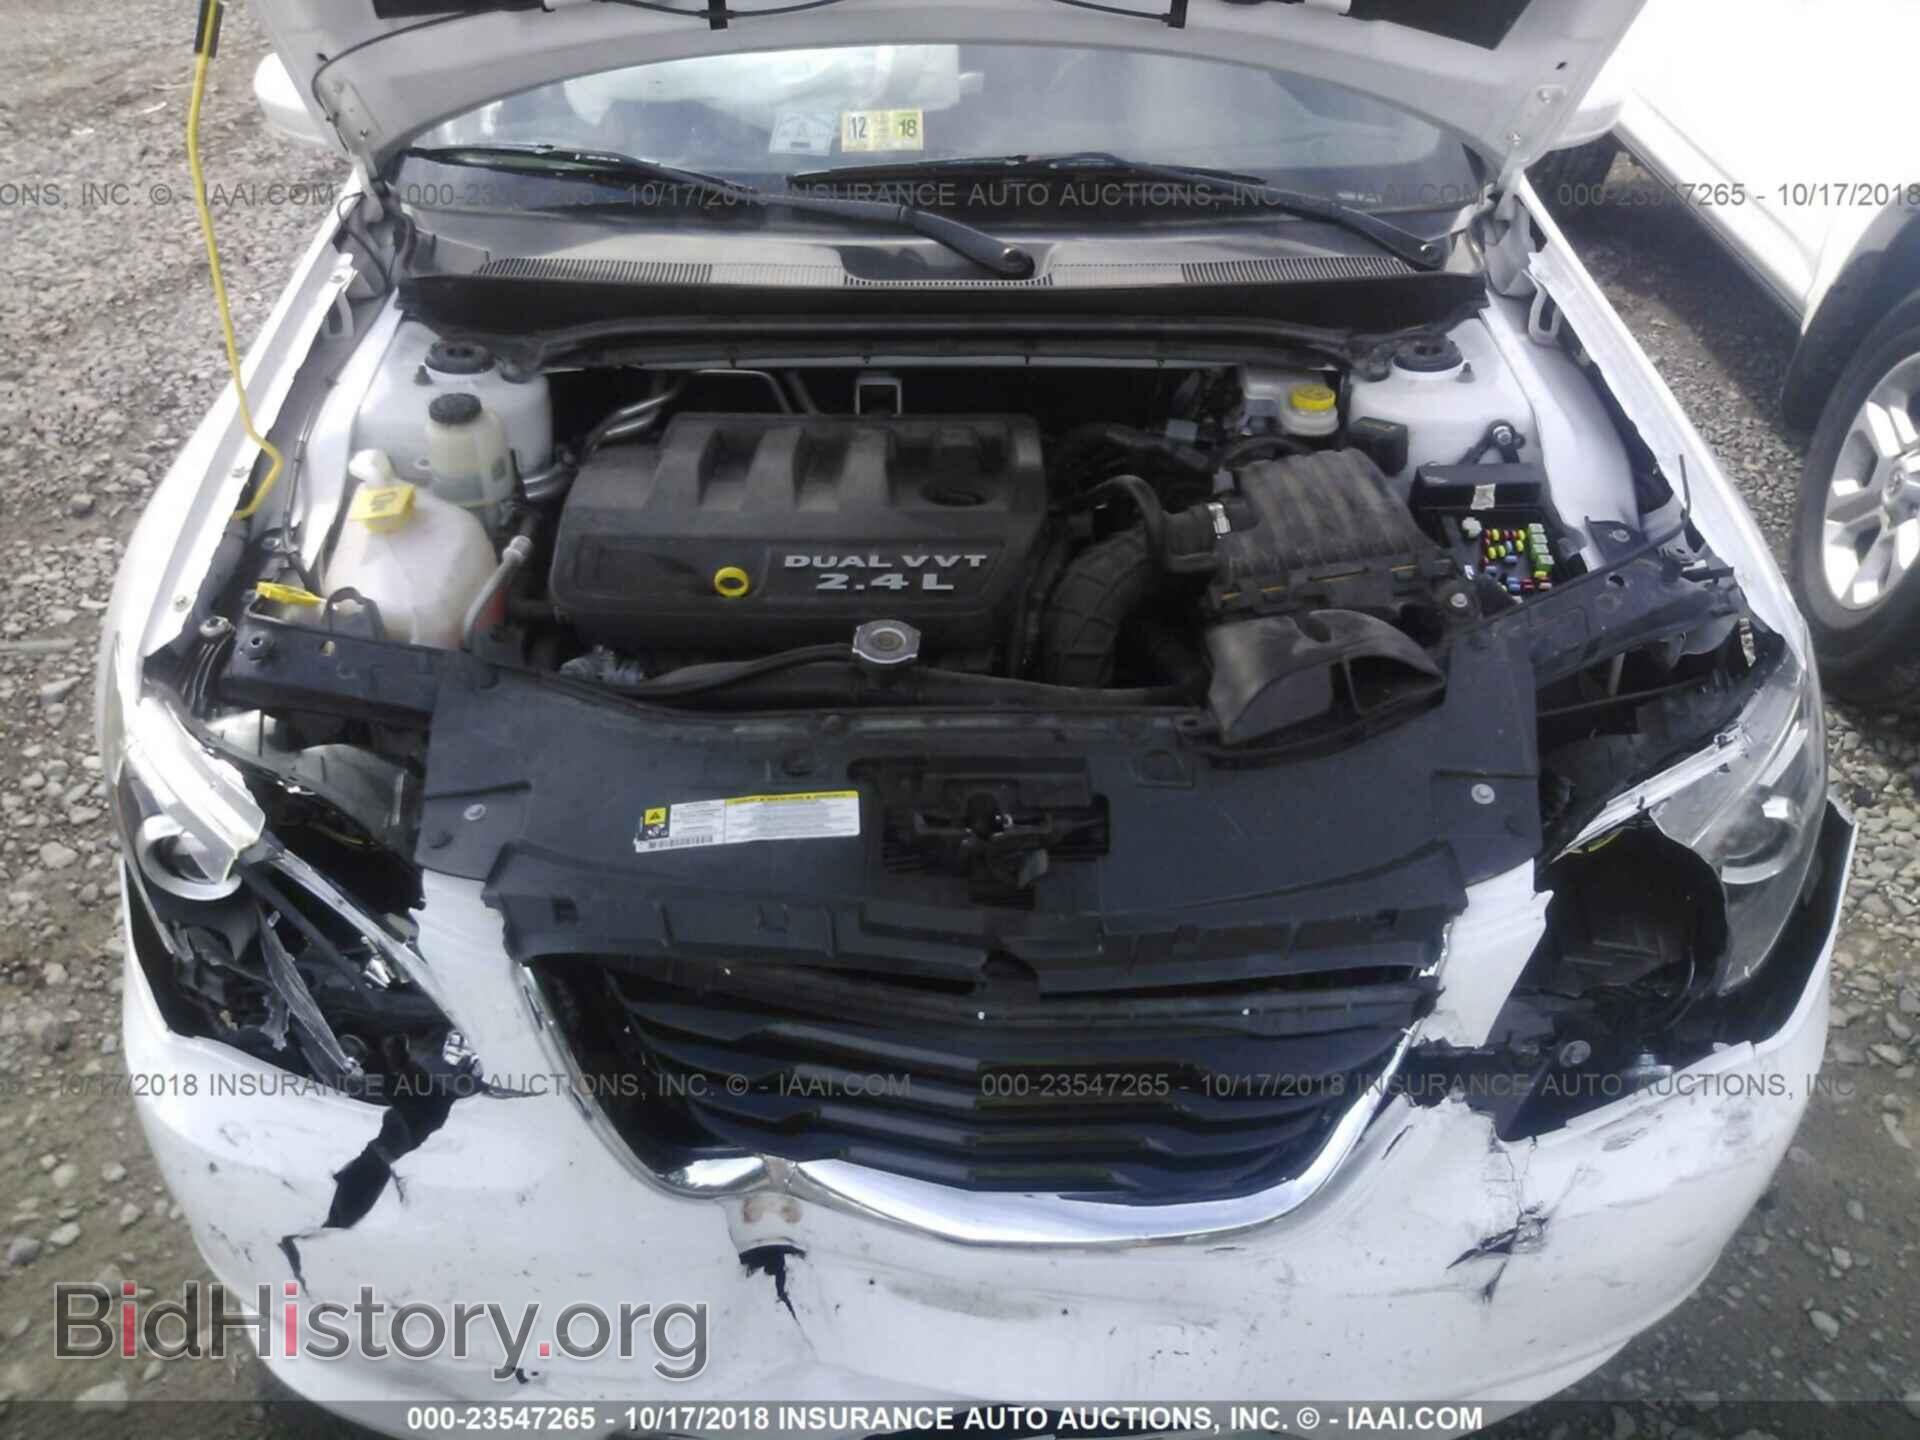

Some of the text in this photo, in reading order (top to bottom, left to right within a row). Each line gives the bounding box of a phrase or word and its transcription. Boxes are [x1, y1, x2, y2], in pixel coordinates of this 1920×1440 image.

[851, 116, 866, 139] 12
[899, 118, 917, 138] 18
[784, 553, 987, 568] DUAL VVT
